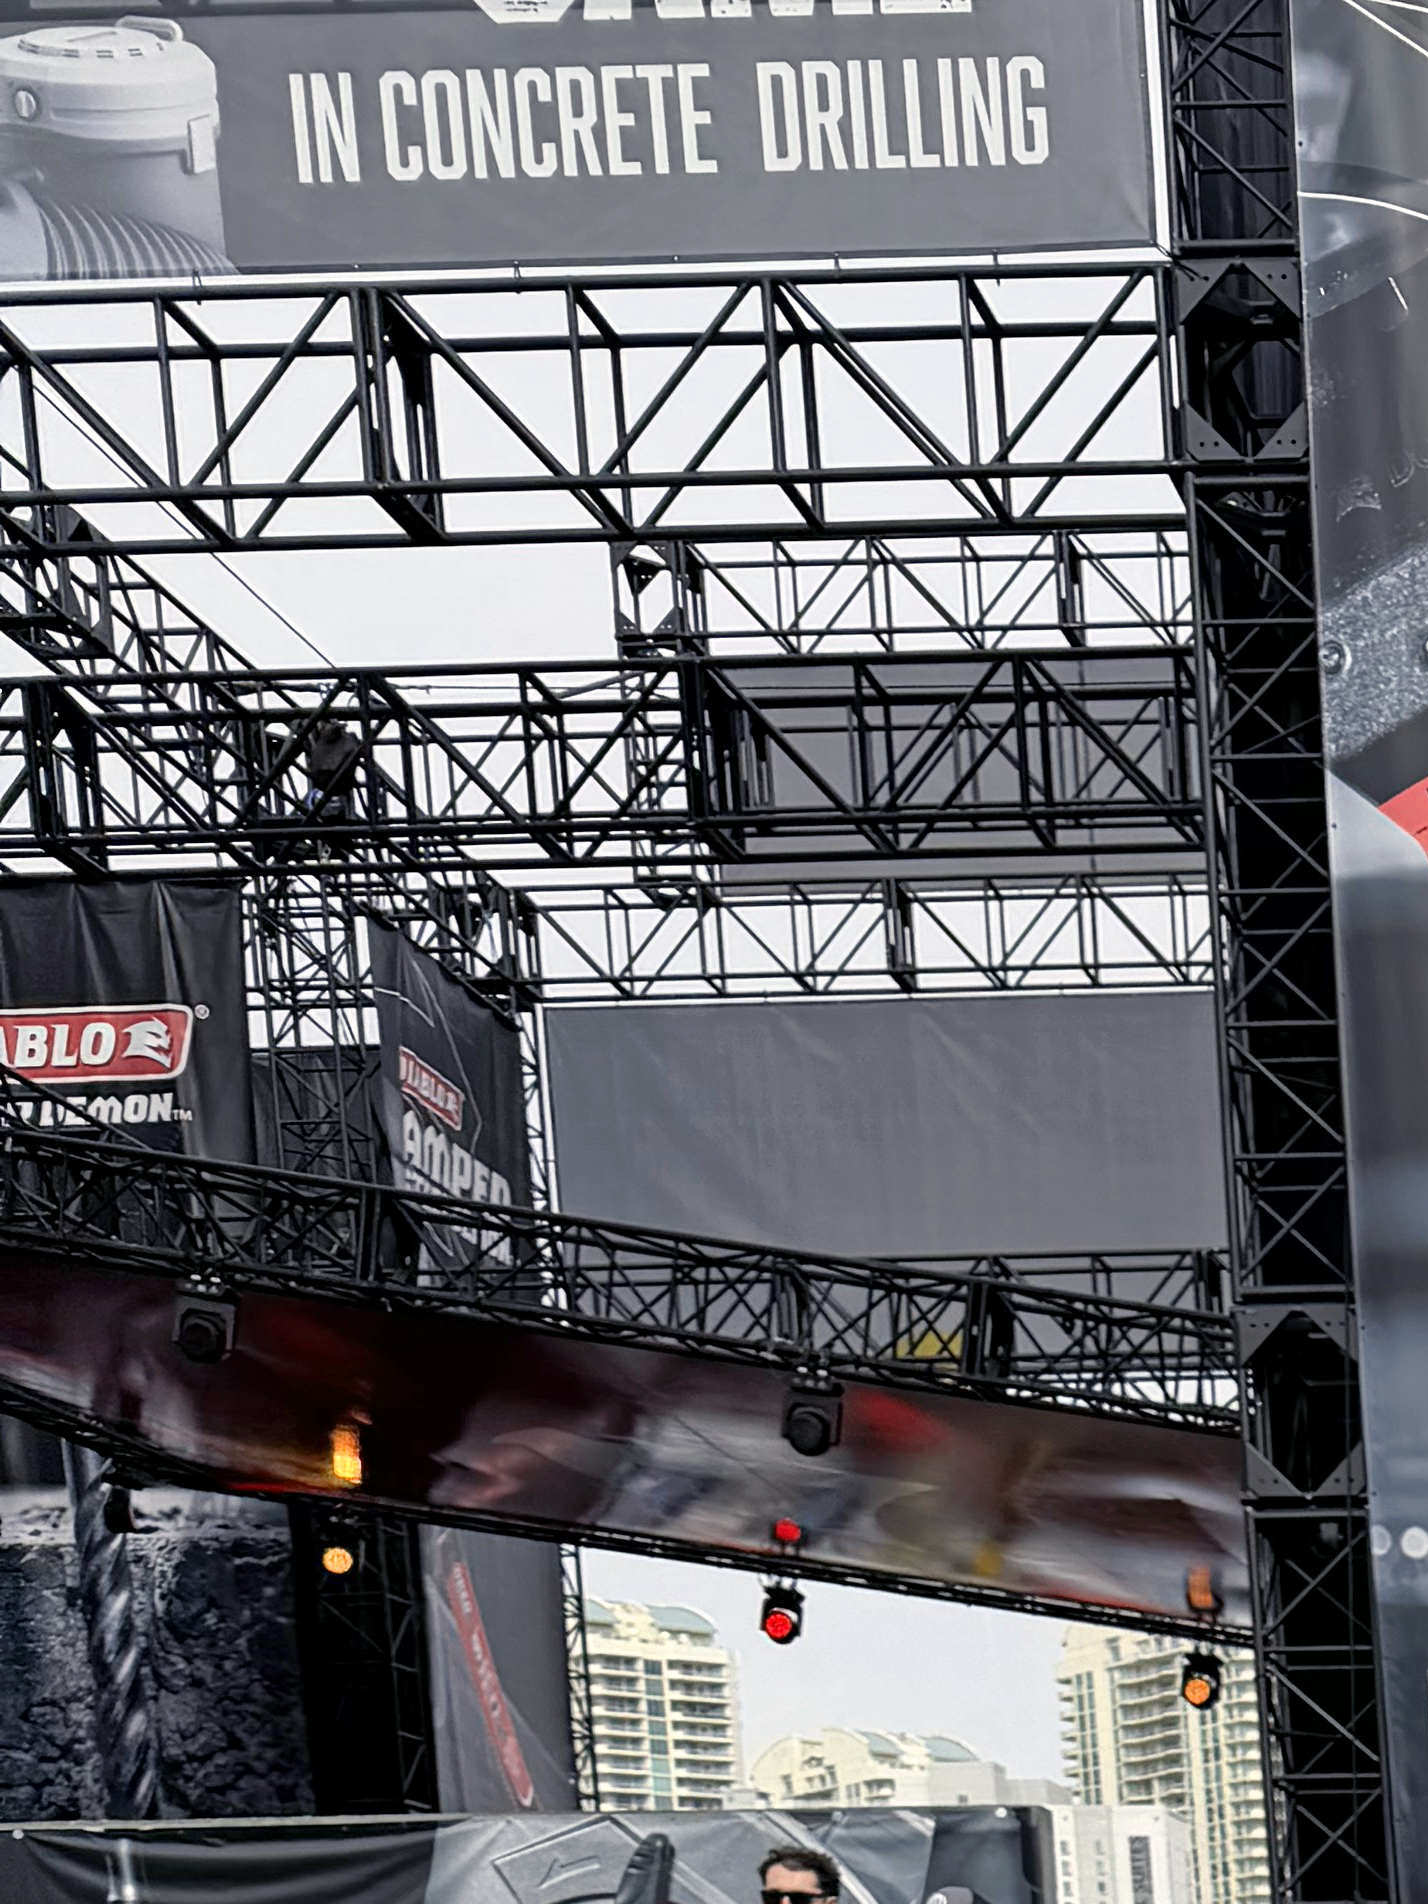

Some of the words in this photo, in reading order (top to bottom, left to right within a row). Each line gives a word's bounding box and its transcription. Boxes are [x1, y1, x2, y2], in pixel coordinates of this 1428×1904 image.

[289, 72, 361, 183] IN
[379, 63, 718, 182] CONCRETE
[756, 55, 1050, 173] DRILLING
